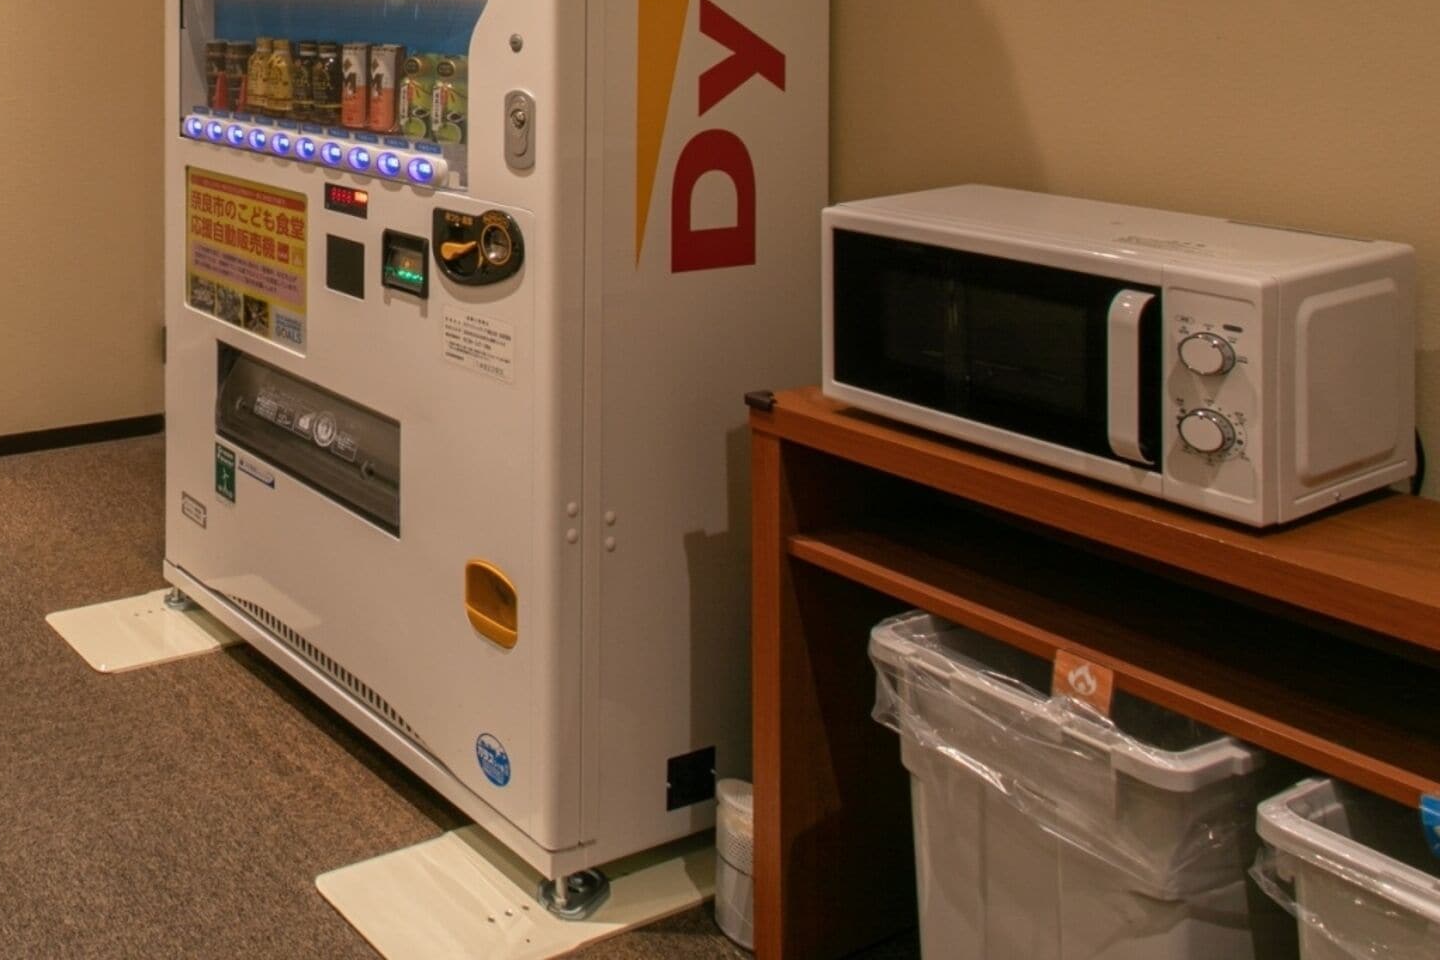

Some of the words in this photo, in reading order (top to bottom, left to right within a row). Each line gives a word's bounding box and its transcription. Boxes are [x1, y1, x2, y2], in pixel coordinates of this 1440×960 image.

[191, 190, 305, 240] 奈良市のこども食堂
